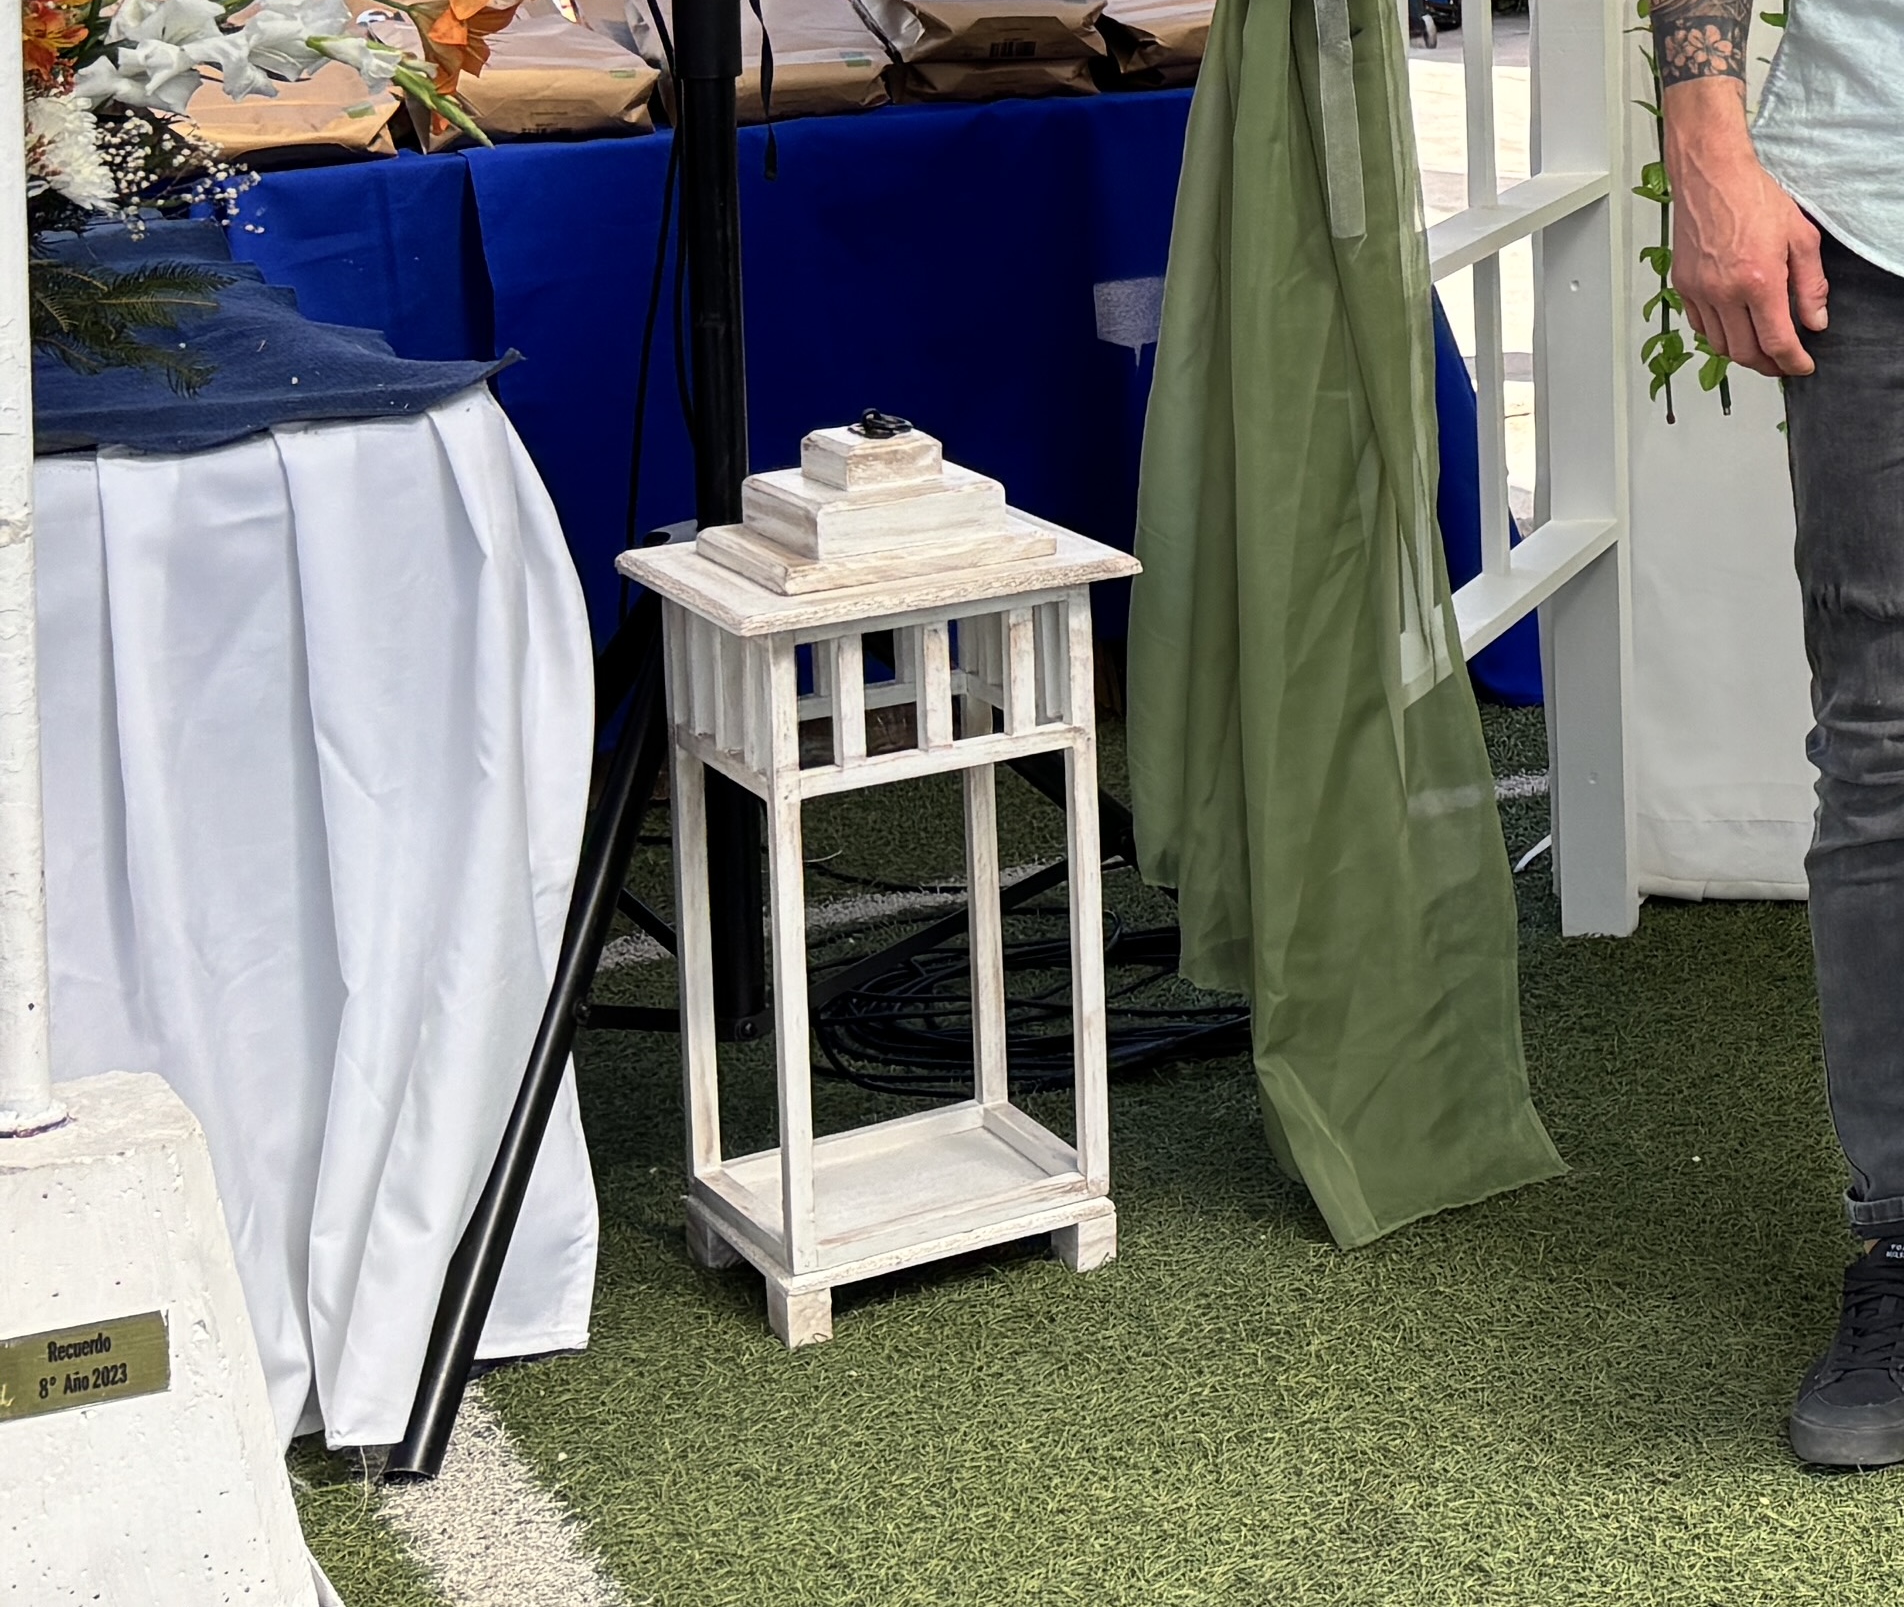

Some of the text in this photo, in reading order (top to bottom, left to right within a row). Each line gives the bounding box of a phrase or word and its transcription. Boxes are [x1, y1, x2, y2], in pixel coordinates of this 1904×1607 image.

[47, 1333, 112, 1363] Recuerdo
[63, 1371, 90, 1395] Año
[92, 1362, 128, 1389] 2023
